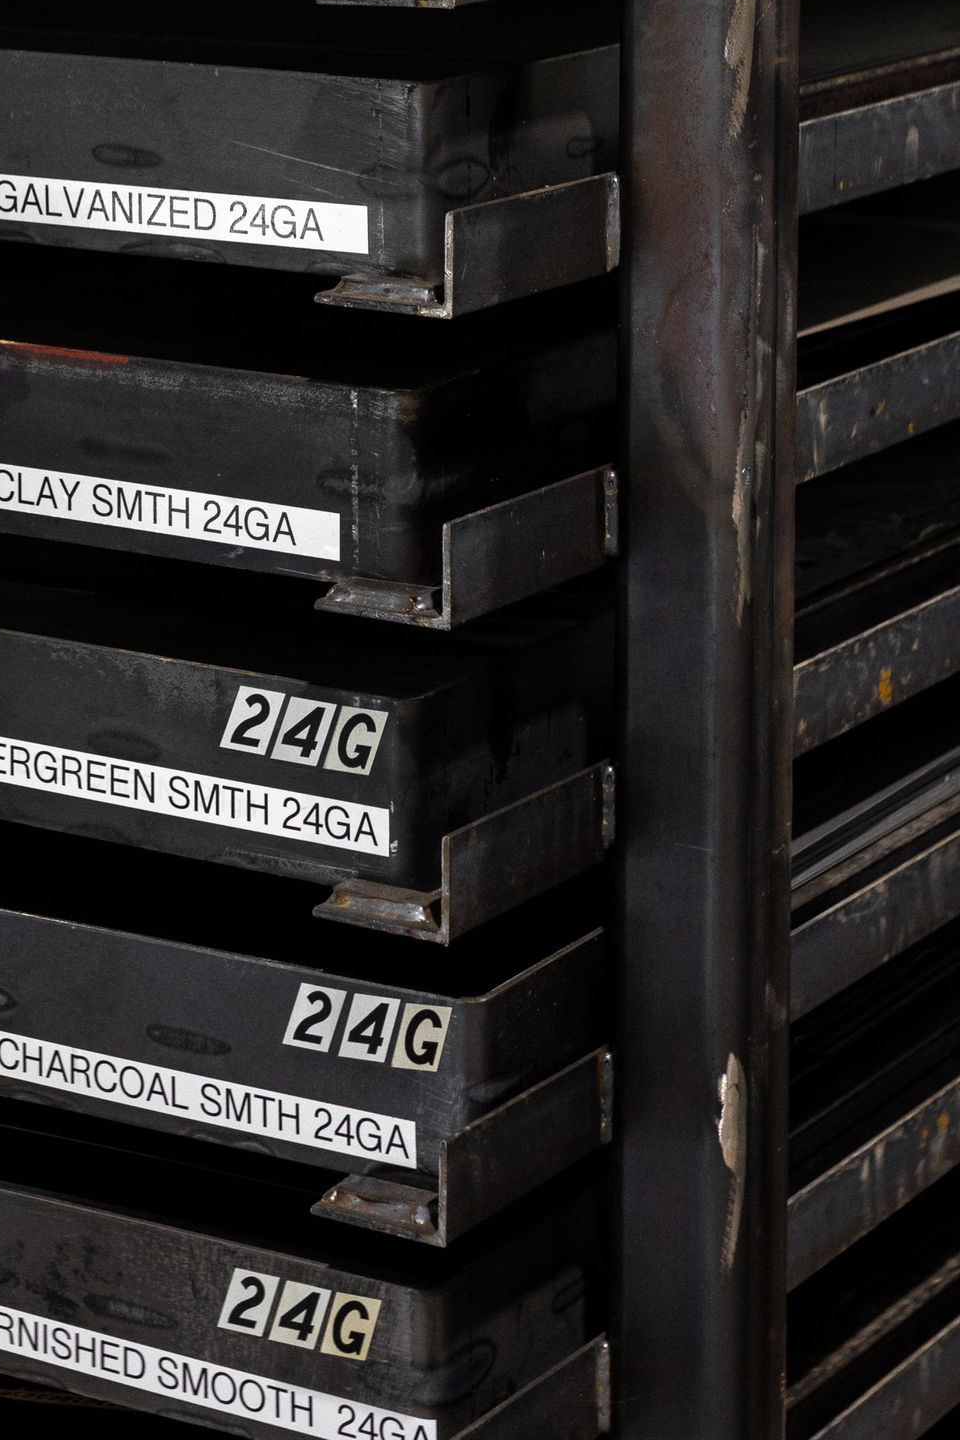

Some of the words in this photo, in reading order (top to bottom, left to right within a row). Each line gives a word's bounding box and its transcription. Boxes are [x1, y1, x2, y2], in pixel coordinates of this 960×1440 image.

[228, 200, 324, 241] 24GA
[93, 484, 190, 529] SMTH
[203, 500, 297, 546] 24GA
[230, 693, 379, 770] 24G
[168, 776, 269, 825] SMTH
[282, 797, 378, 846] 24GA
[292, 990, 442, 1066] 24G
[200, 1083, 300, 1135] SMTH
[313, 1107, 410, 1160] 24GA
[227, 1276, 370, 1355] 24G
[157, 1356, 313, 1427] SMOOTH
